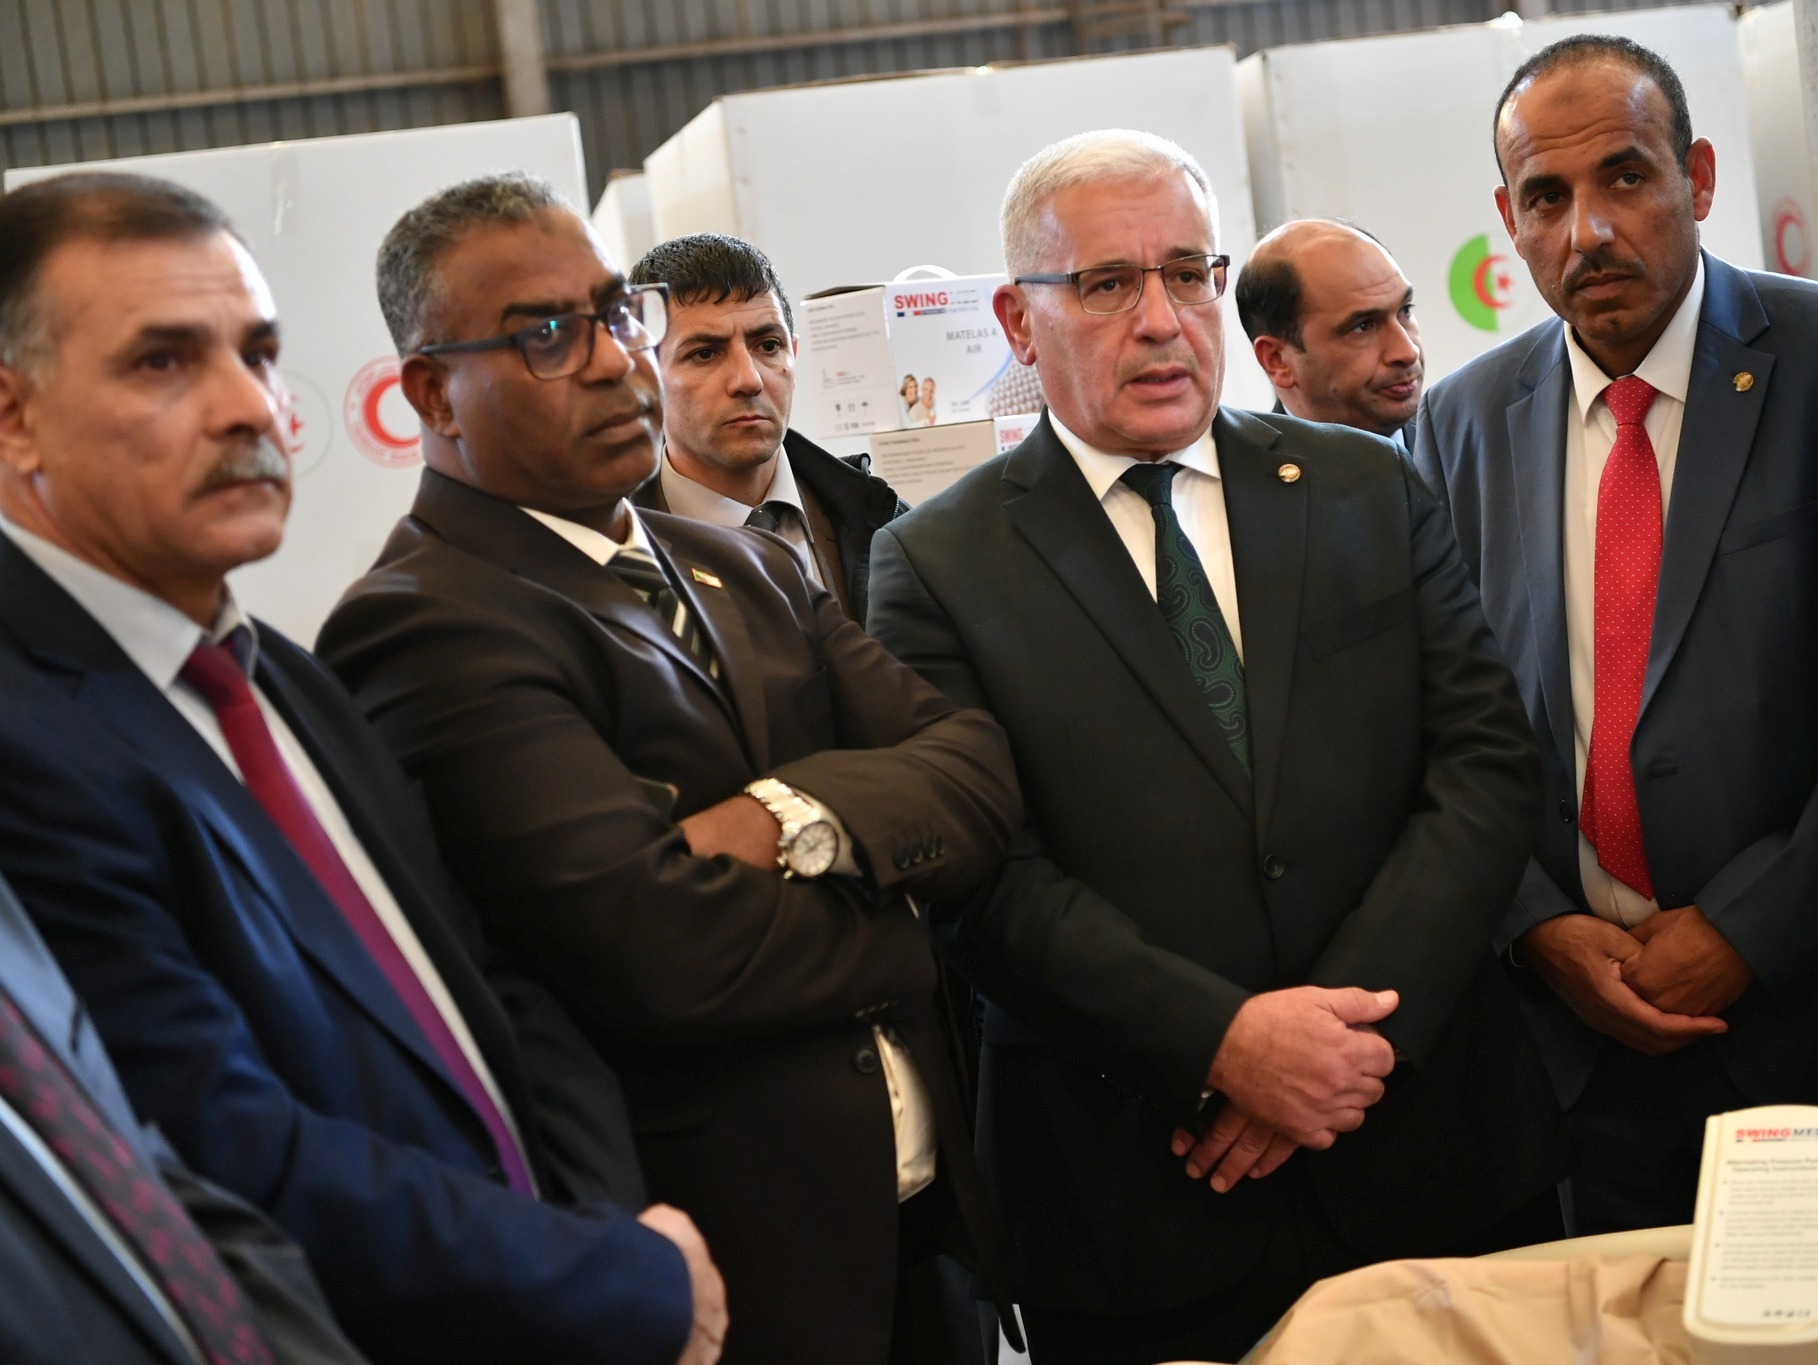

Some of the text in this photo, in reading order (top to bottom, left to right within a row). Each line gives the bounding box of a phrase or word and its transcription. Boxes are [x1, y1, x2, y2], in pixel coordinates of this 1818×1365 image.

[946, 328, 998, 341] MATELAS A
[966, 344, 982, 354] AIR
